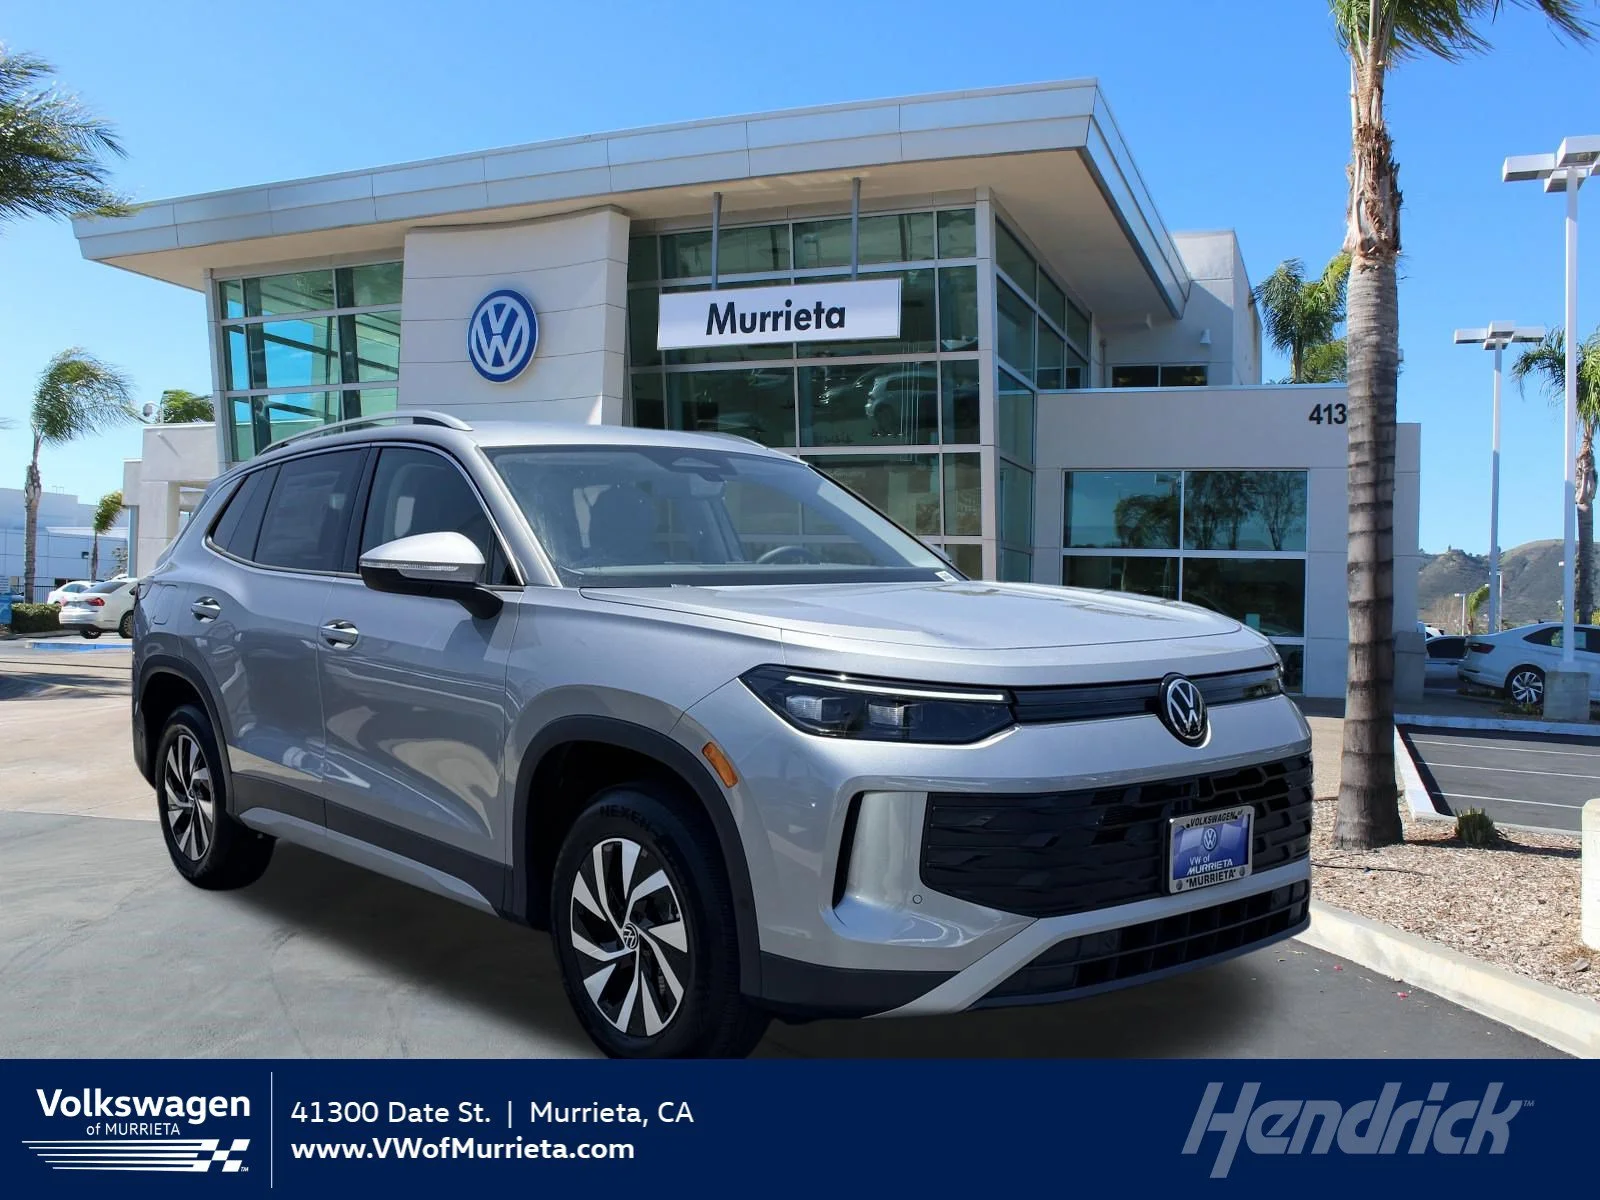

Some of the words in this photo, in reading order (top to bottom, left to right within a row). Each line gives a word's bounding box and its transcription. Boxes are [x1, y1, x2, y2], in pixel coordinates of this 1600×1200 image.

[705, 299, 847, 337] Murrieta
[1308, 403, 1348, 425] 413
[1190, 811, 1236, 827] VOLKSWAGEN
[1186, 858, 1234, 876] MURRIETA
[1189, 856, 1202, 866] VW
[1203, 854, 1210, 863] of
[1187, 869, 1236, 888] MURRIETA
